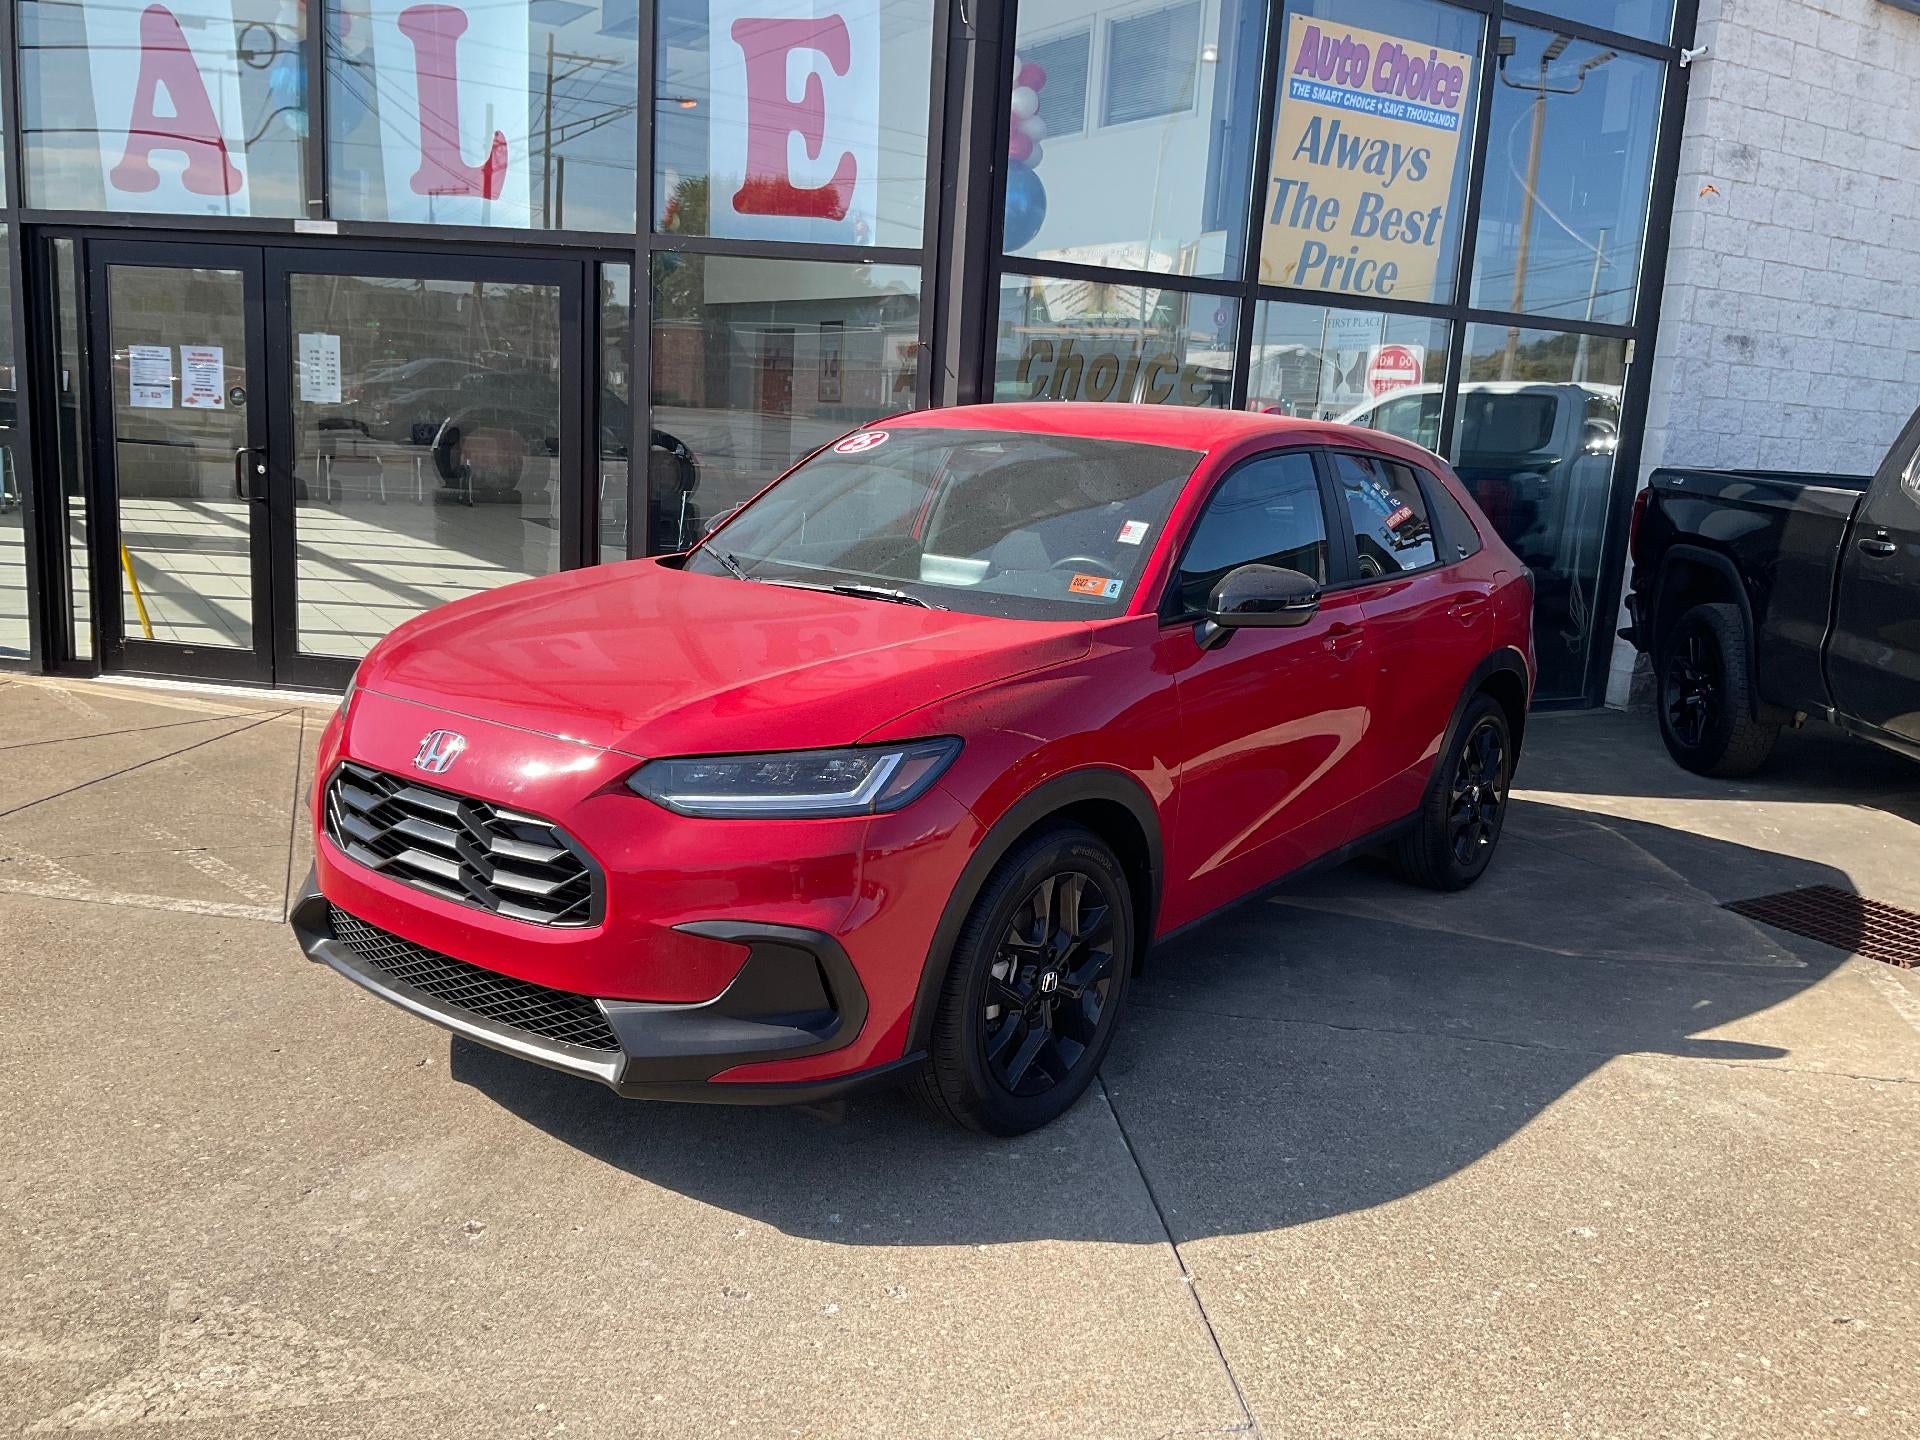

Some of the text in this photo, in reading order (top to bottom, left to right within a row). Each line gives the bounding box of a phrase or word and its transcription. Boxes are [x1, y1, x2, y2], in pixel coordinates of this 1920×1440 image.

[1294, 25, 1464, 108] Auto Choice
[1292, 82, 1457, 128] THE SMART CHOICE SAVE THOUSANDS
[1292, 115, 1431, 188] Always
[1270, 177, 1442, 246] The Best
[1293, 240, 1398, 296] Price
[1327, 318, 1352, 329] FIRST
[1015, 338, 1213, 407] Choice
